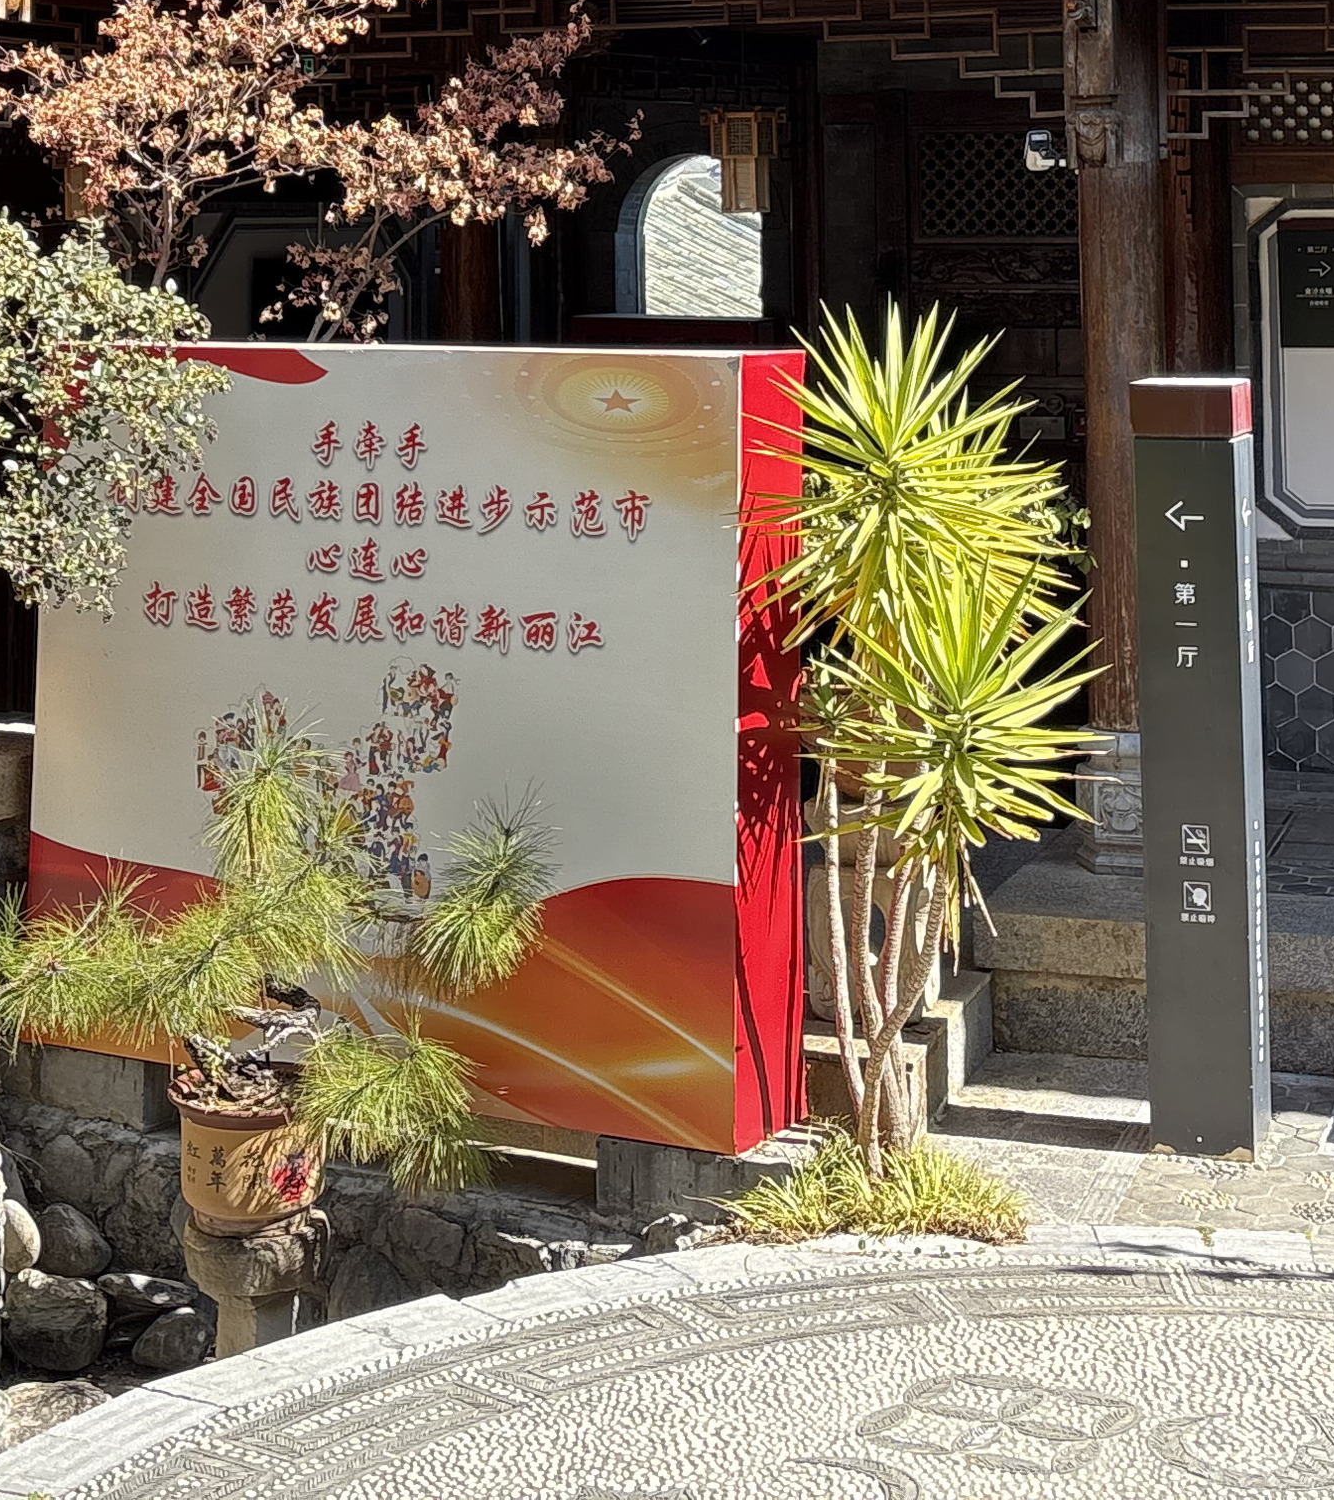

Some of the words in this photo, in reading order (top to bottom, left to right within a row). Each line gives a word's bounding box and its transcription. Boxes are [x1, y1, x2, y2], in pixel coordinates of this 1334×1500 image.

[312, 420, 428, 468] 手牵手
[308, 540, 428, 581] 心连心
[143, 581, 605, 653] 打造繁荣发展和谐新丽江
[1174, 582, 1199, 668] 第一厅
[206, 1145, 227, 1194] 萬年
